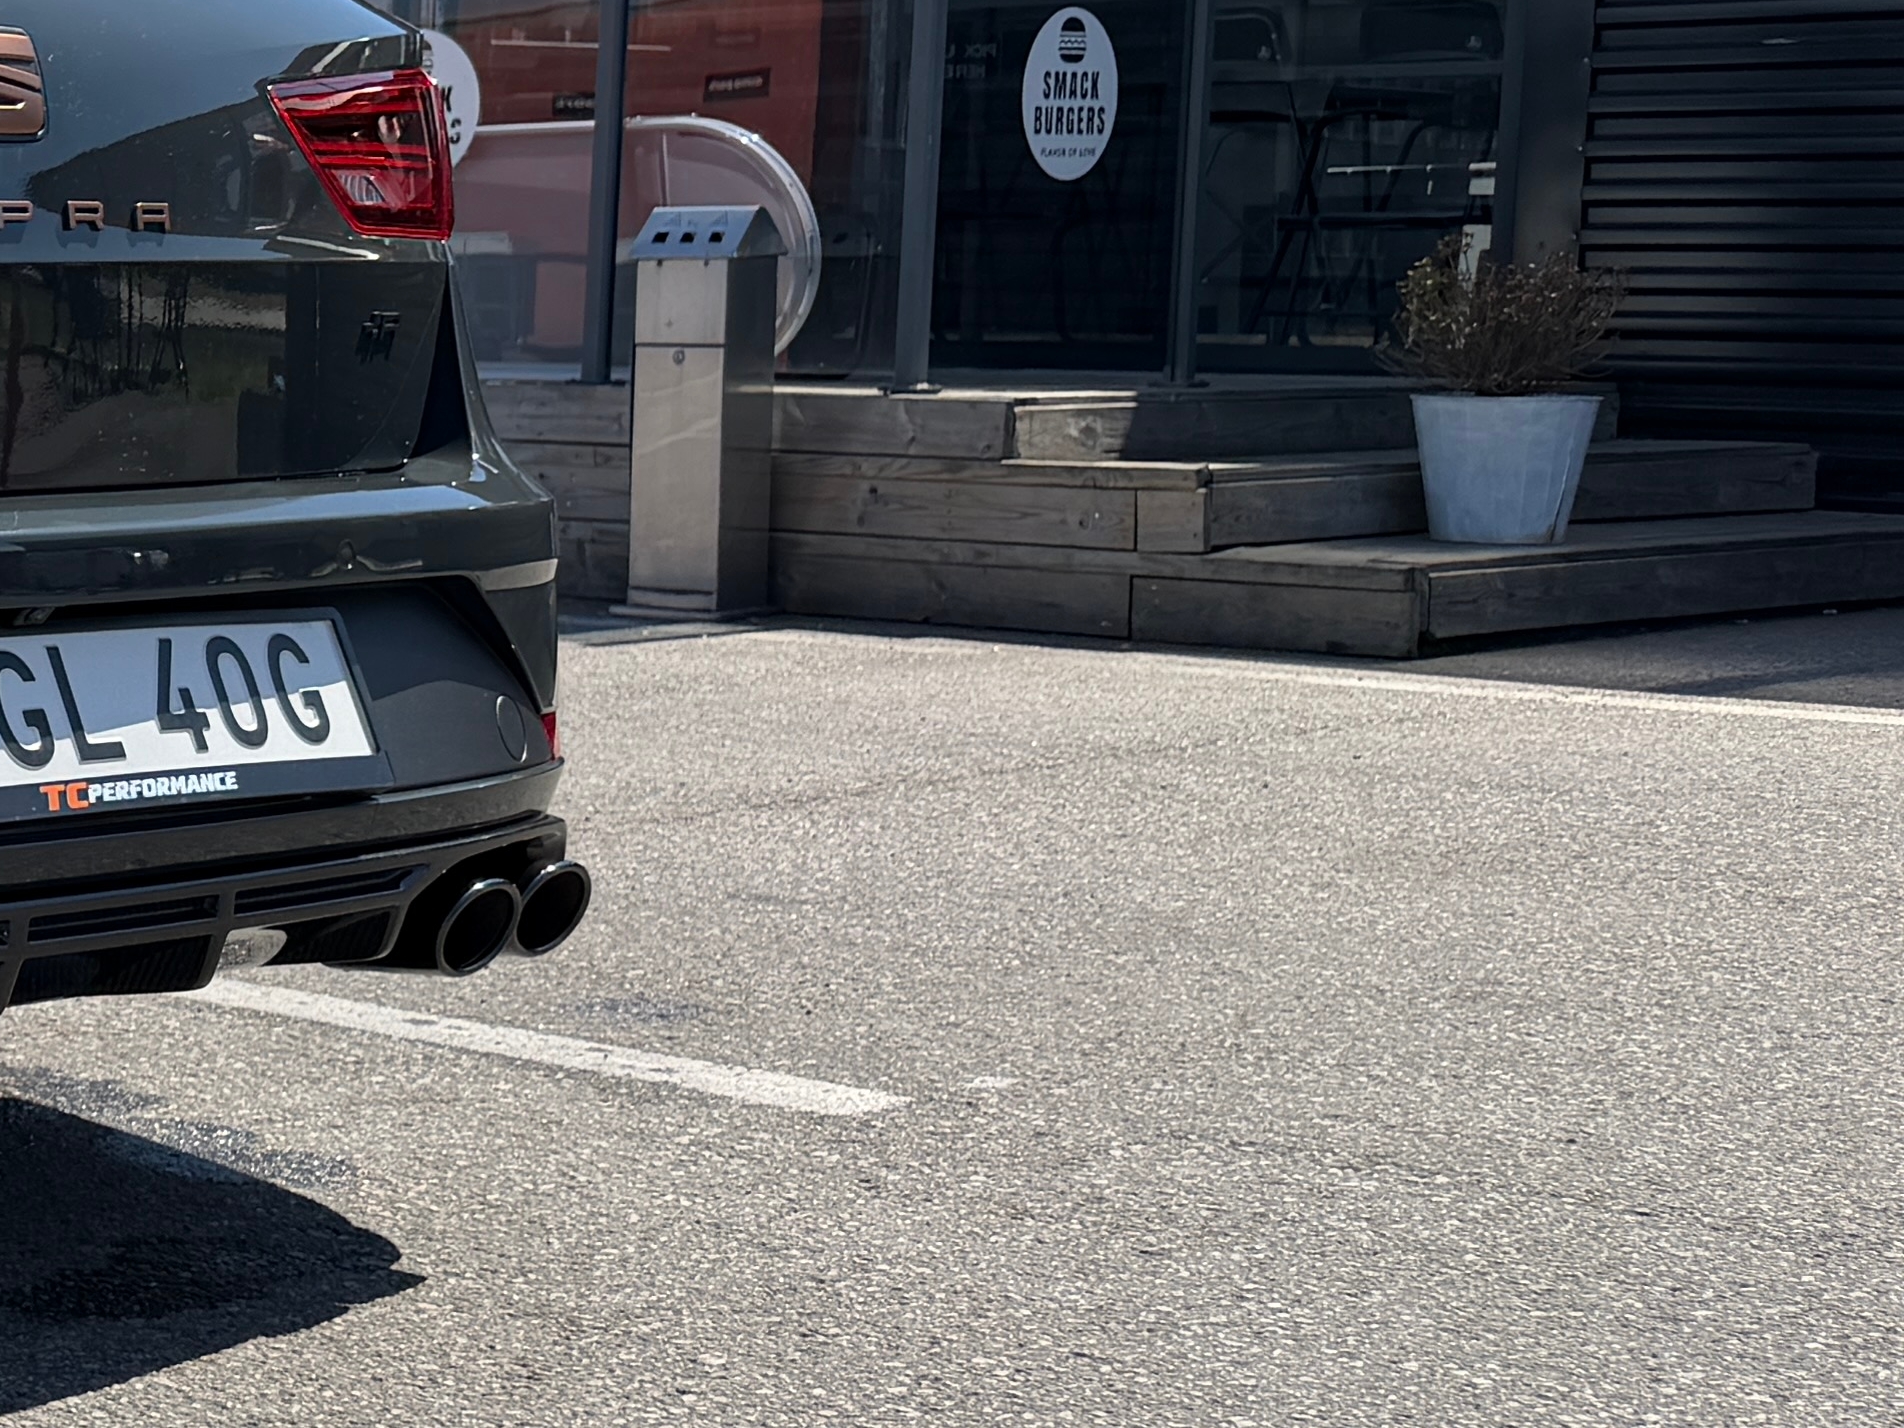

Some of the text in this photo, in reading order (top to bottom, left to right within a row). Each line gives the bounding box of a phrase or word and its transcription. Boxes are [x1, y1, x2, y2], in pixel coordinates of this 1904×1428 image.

[1042, 70, 1101, 101] SMACK
[1033, 105, 1106, 135] BURGERS
[155, 632, 331, 754] 40G
